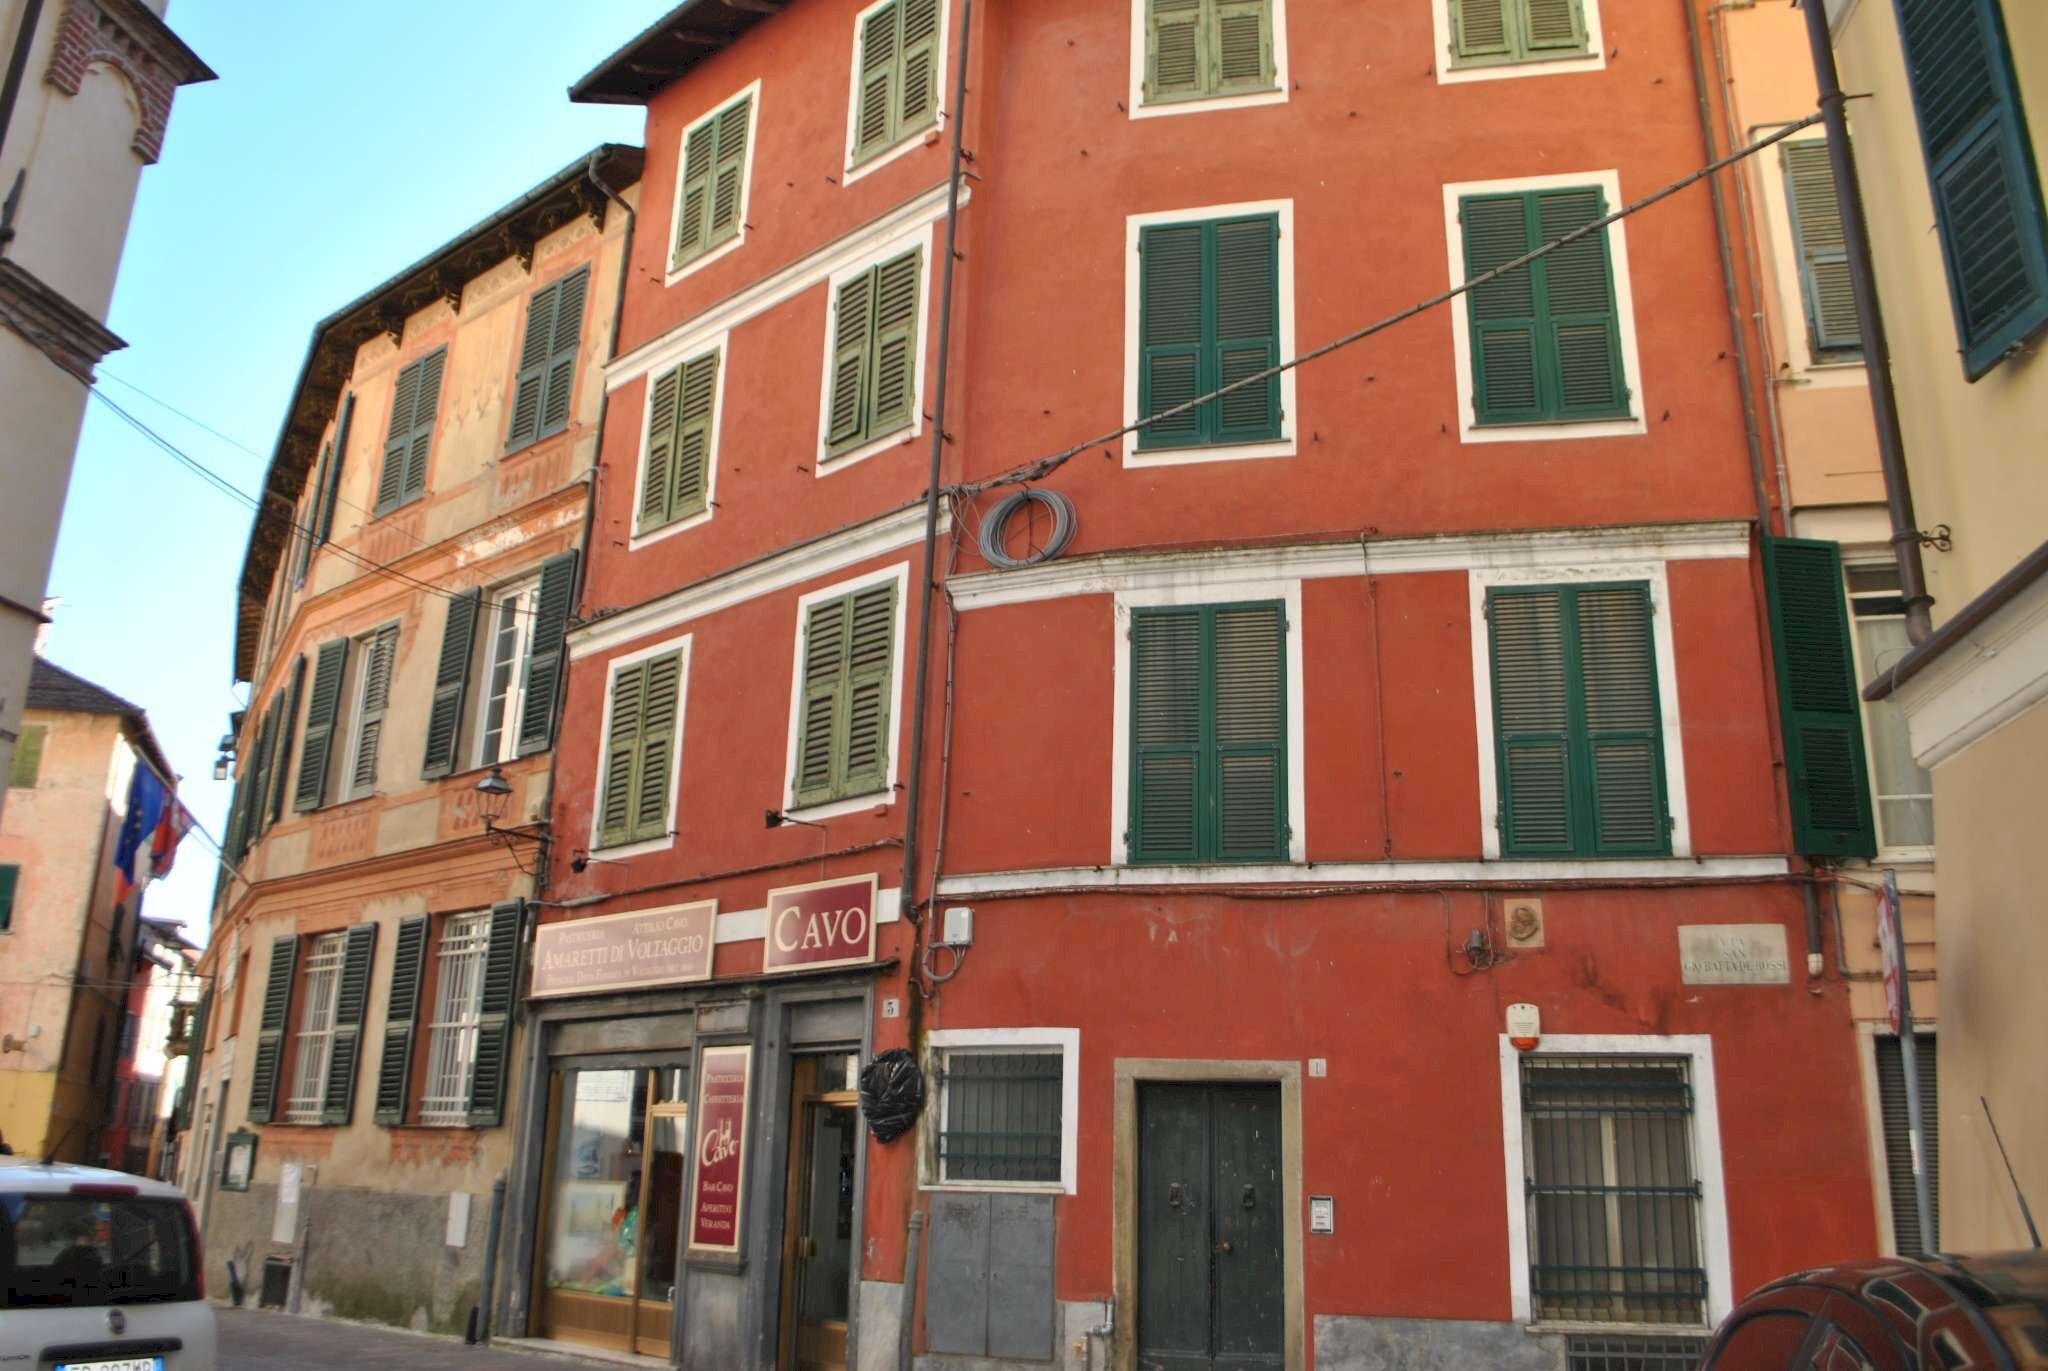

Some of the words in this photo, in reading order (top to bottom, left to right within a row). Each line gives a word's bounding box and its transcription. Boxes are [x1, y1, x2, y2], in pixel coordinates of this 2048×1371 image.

[773, 905, 867, 953] CAVO
[541, 947, 608, 970] AMARETTI
[610, 944, 625, 962] DI
[628, 934, 704, 960] VOLTAGGIO
